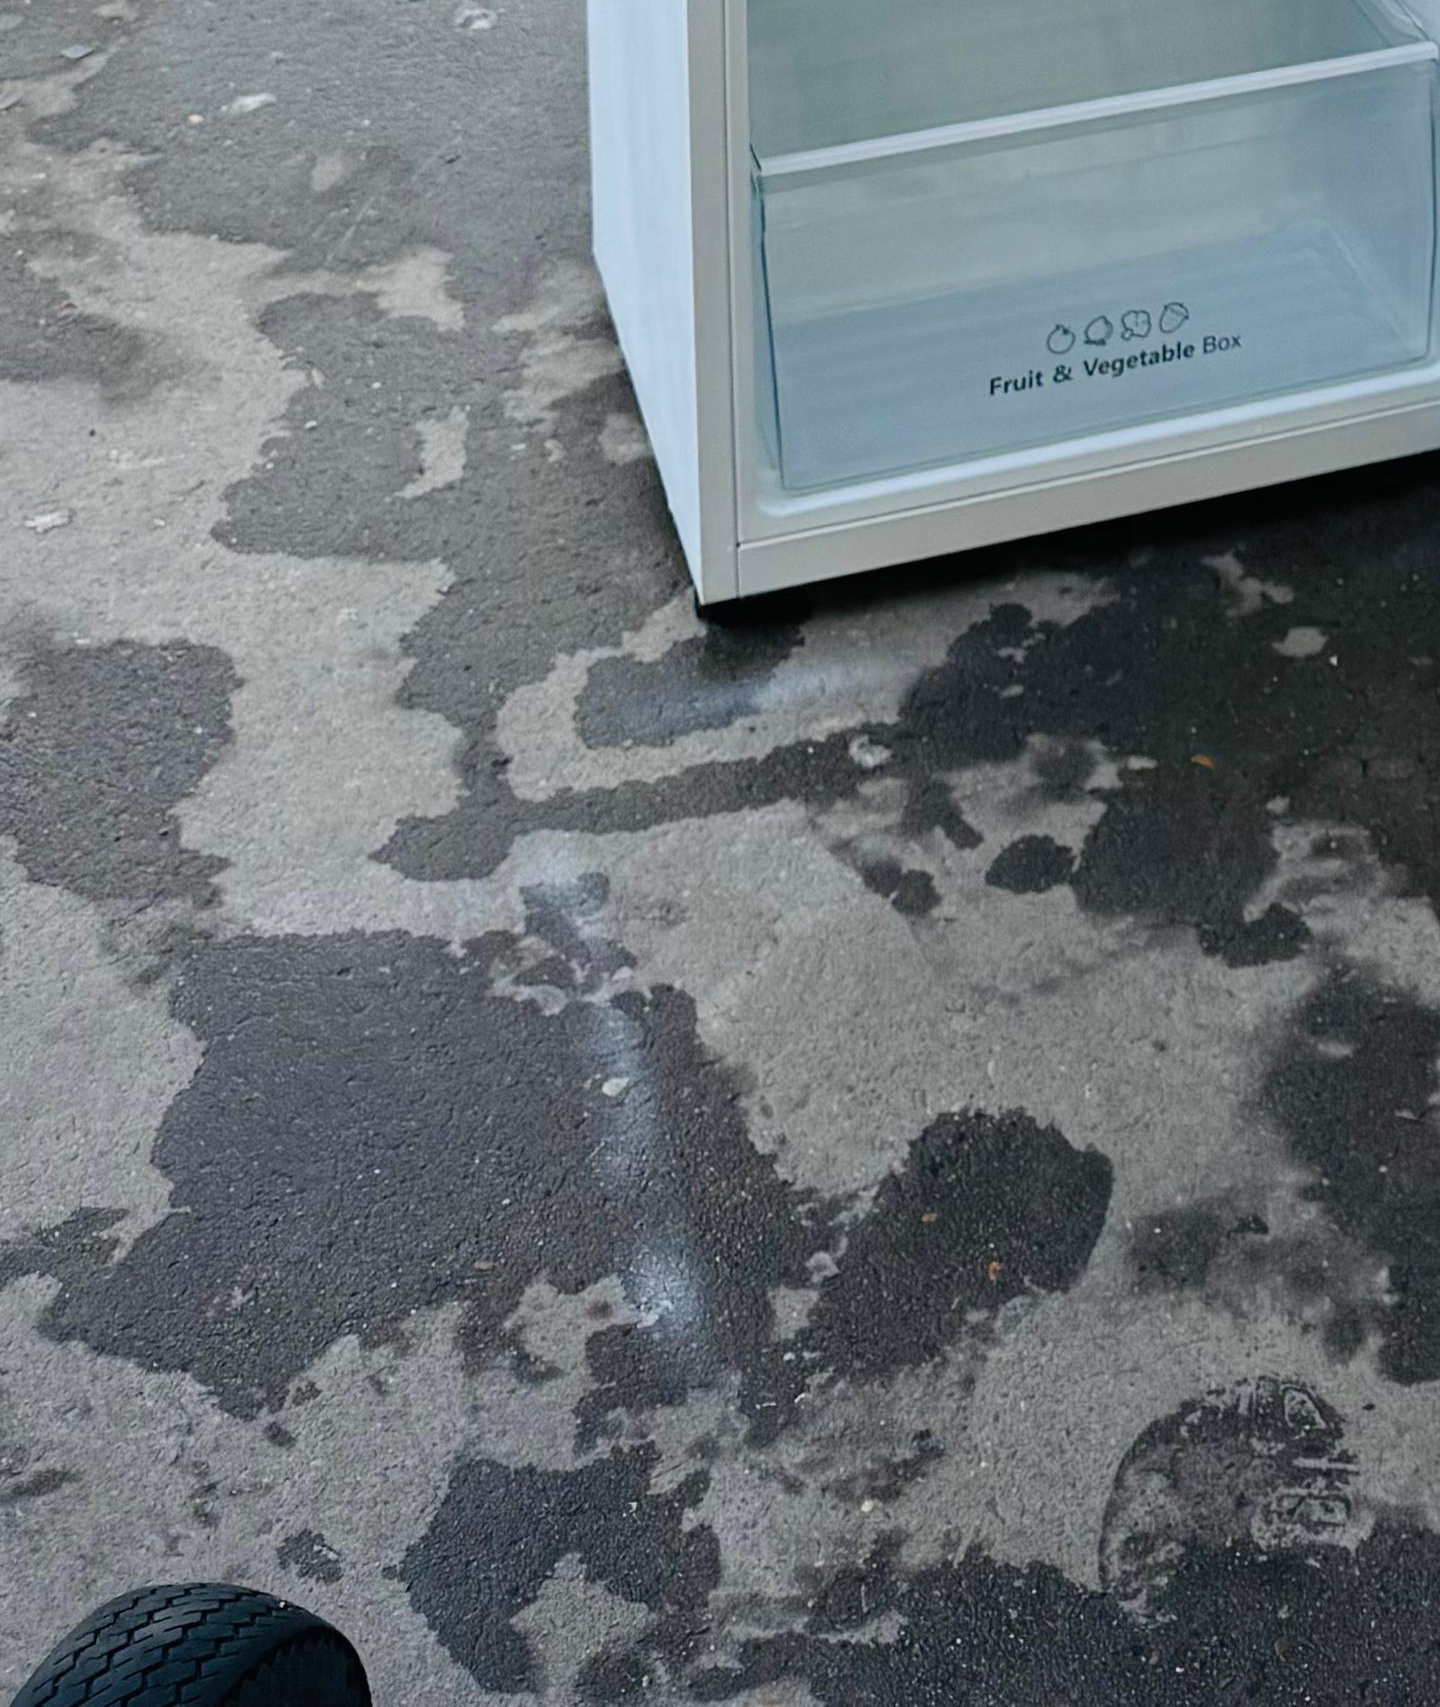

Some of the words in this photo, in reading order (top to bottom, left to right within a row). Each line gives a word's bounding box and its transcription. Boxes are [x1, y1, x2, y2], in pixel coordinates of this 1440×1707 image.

[989, 369, 1044, 396] Fruit
[1052, 363, 1073, 383] &
[1083, 341, 1196, 378] Vegetable
[1202, 333, 1243, 355] Box
